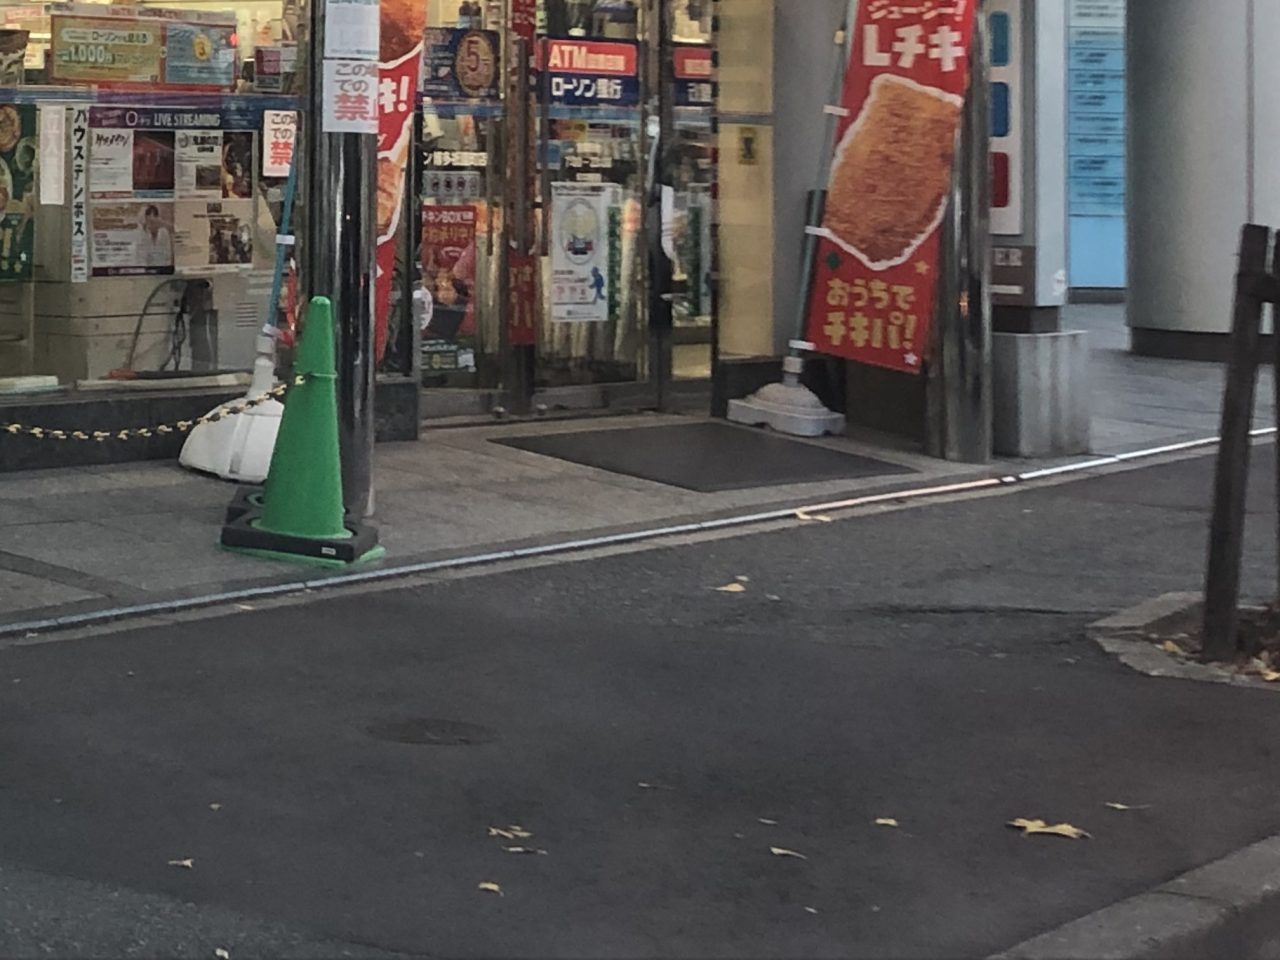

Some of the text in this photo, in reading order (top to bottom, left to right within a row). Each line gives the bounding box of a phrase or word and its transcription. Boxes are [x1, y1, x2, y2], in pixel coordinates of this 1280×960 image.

[862, 23, 967, 72] Lチキ
[825, 277, 916, 310] おうちで
